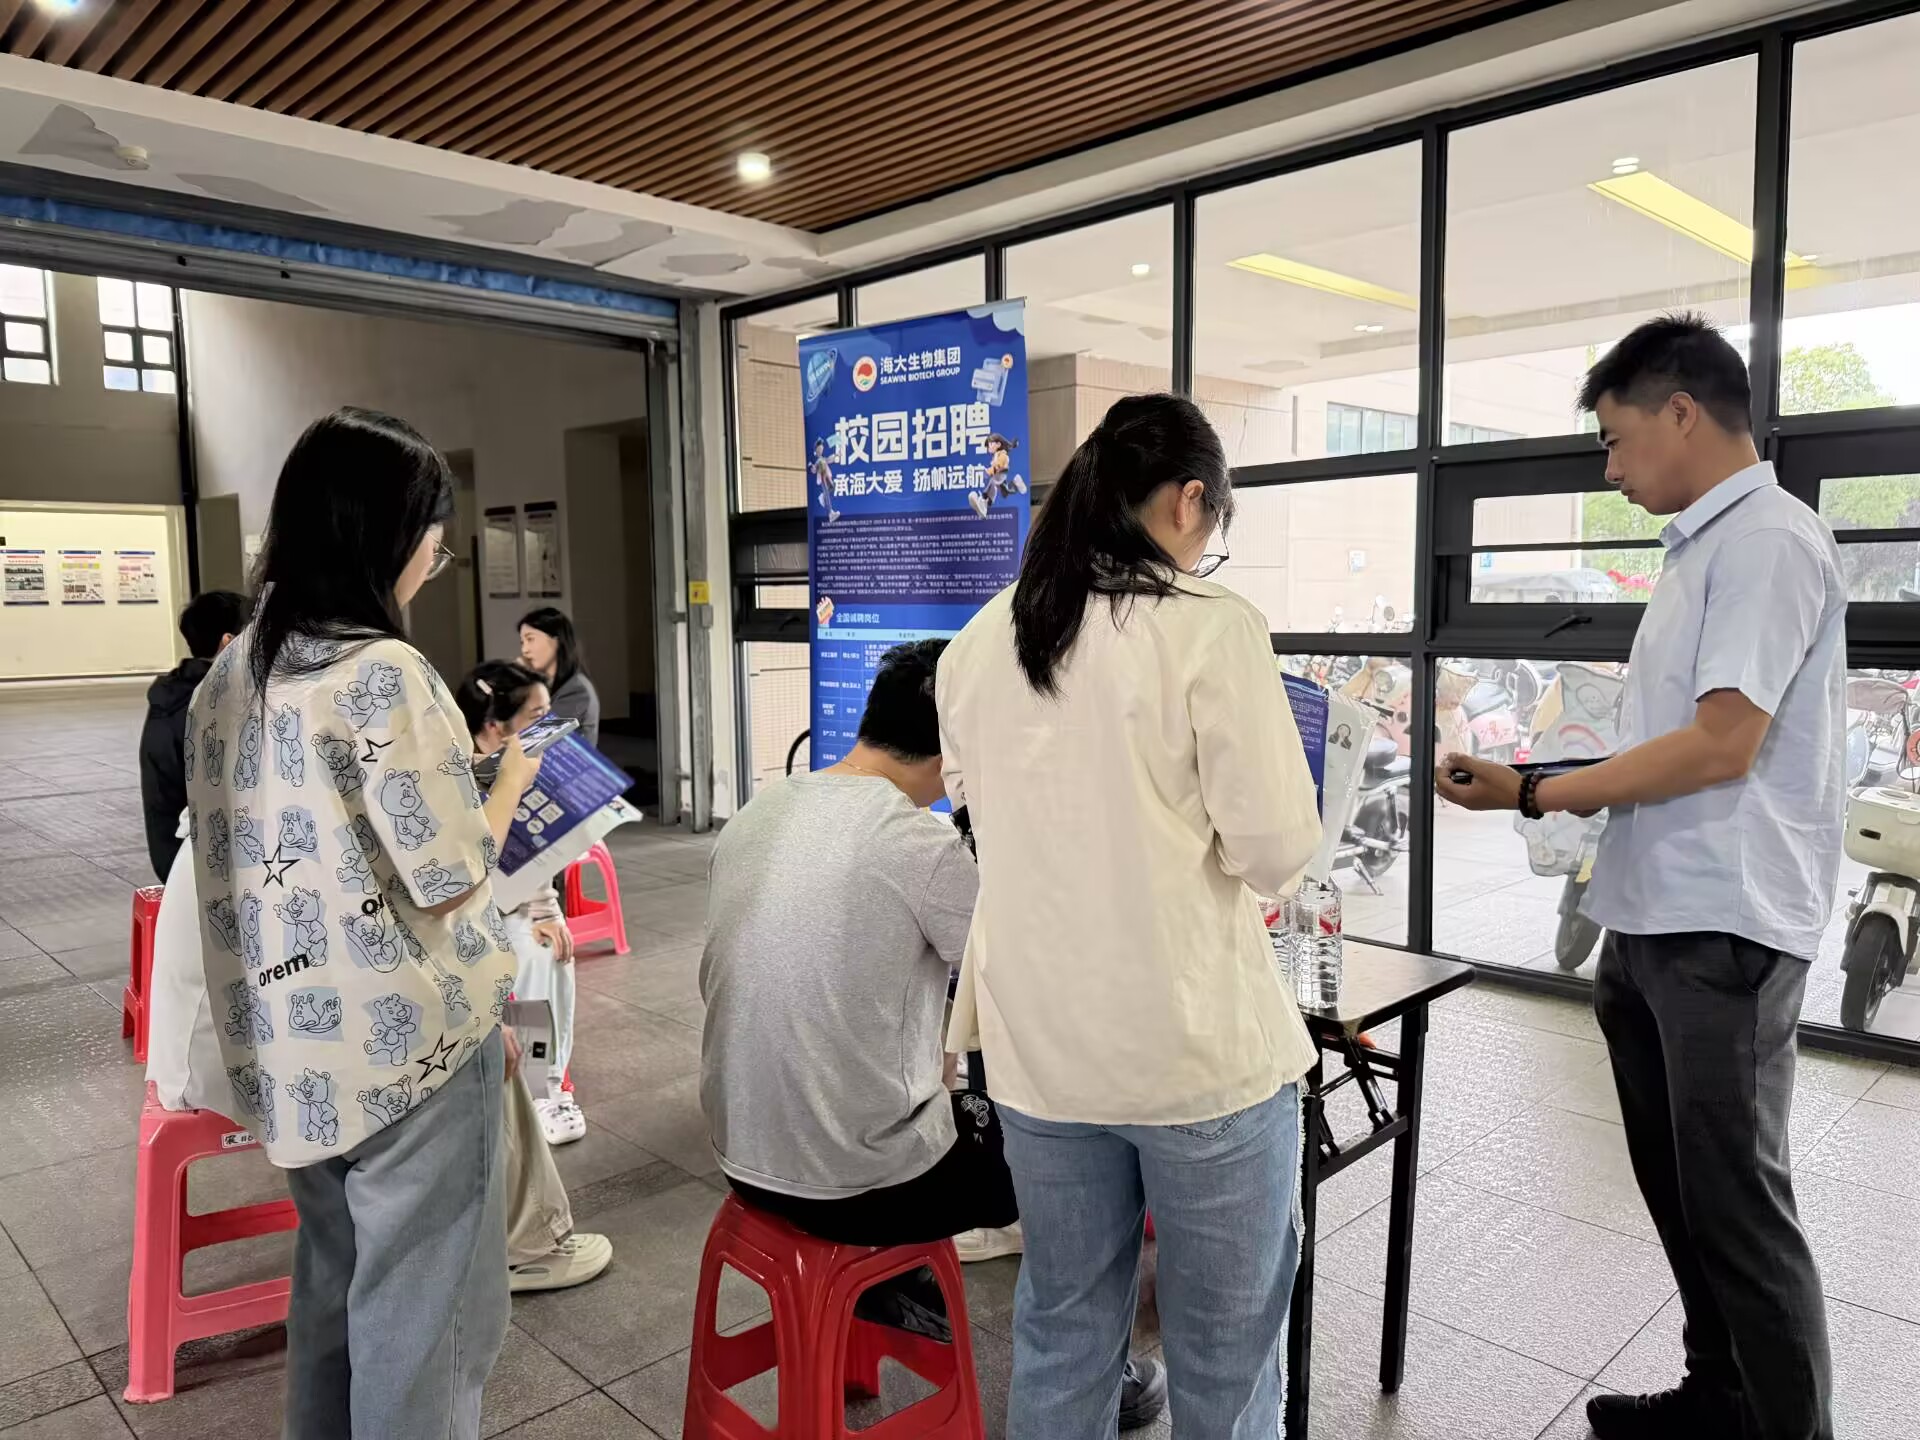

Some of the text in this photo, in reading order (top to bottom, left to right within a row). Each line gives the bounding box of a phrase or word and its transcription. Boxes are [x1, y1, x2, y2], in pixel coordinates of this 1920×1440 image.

[880, 346, 961, 375] 海大生物集团
[880, 366, 961, 385] SEAWIN BIOTECH GROUP
[834, 401, 991, 465] 校园招聘
[834, 463, 985, 497] 承海大爱 扬帆远航
[259, 953, 310, 987] orem
